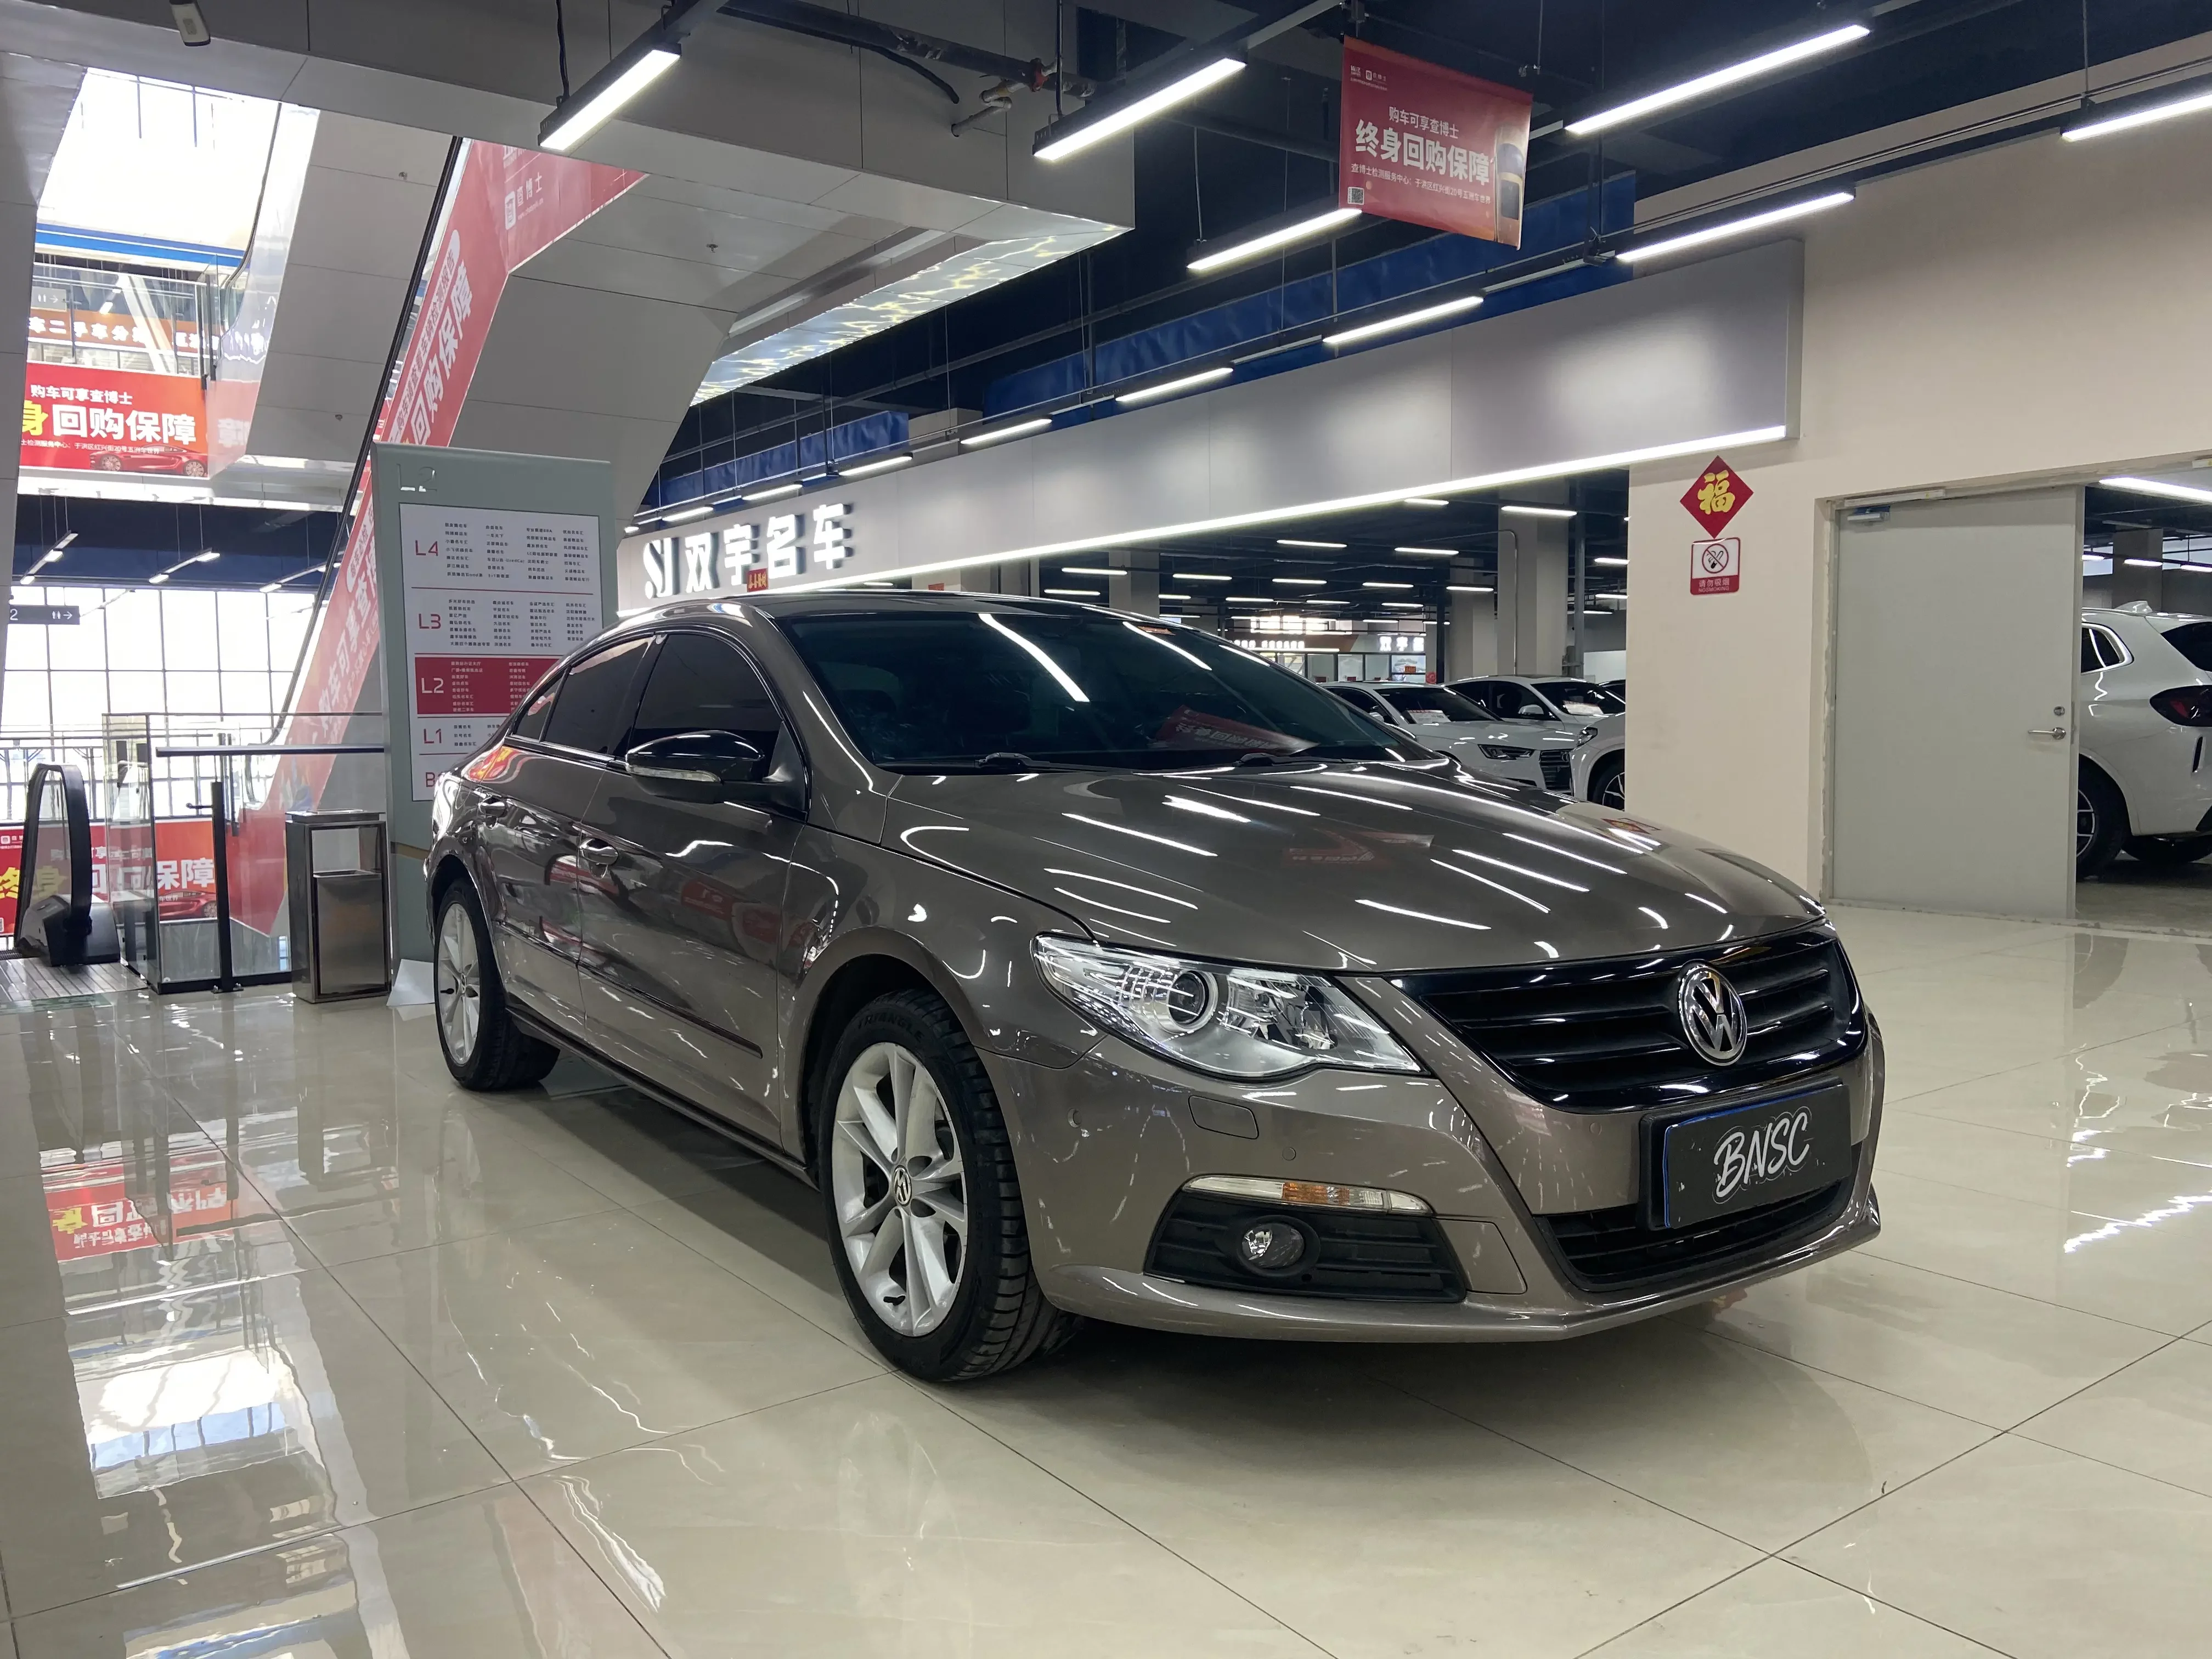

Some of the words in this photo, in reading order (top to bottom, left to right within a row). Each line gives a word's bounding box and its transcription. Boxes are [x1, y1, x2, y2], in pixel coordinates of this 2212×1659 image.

[1389, 106, 1459, 139] 购车可享查博士
[1355, 119, 1490, 186] 终身回购保障
[517, 172, 543, 207] 查博士
[30, 385, 133, 405] 购车可享查博士
[397, 463, 438, 492] L2
[1697, 470, 1735, 515] 福
[415, 540, 439, 556] L4
[685, 503, 854, 594] 双宇名车
[1699, 578, 1730, 588] 请勿吸烟
[419, 613, 441, 629] L3
[421, 678, 444, 693] L2
[424, 729, 442, 744] L1
[426, 772, 442, 787] B
[857, 1012, 925, 1043] TRIANGLE
[1713, 1110, 1812, 1198] BNSC
